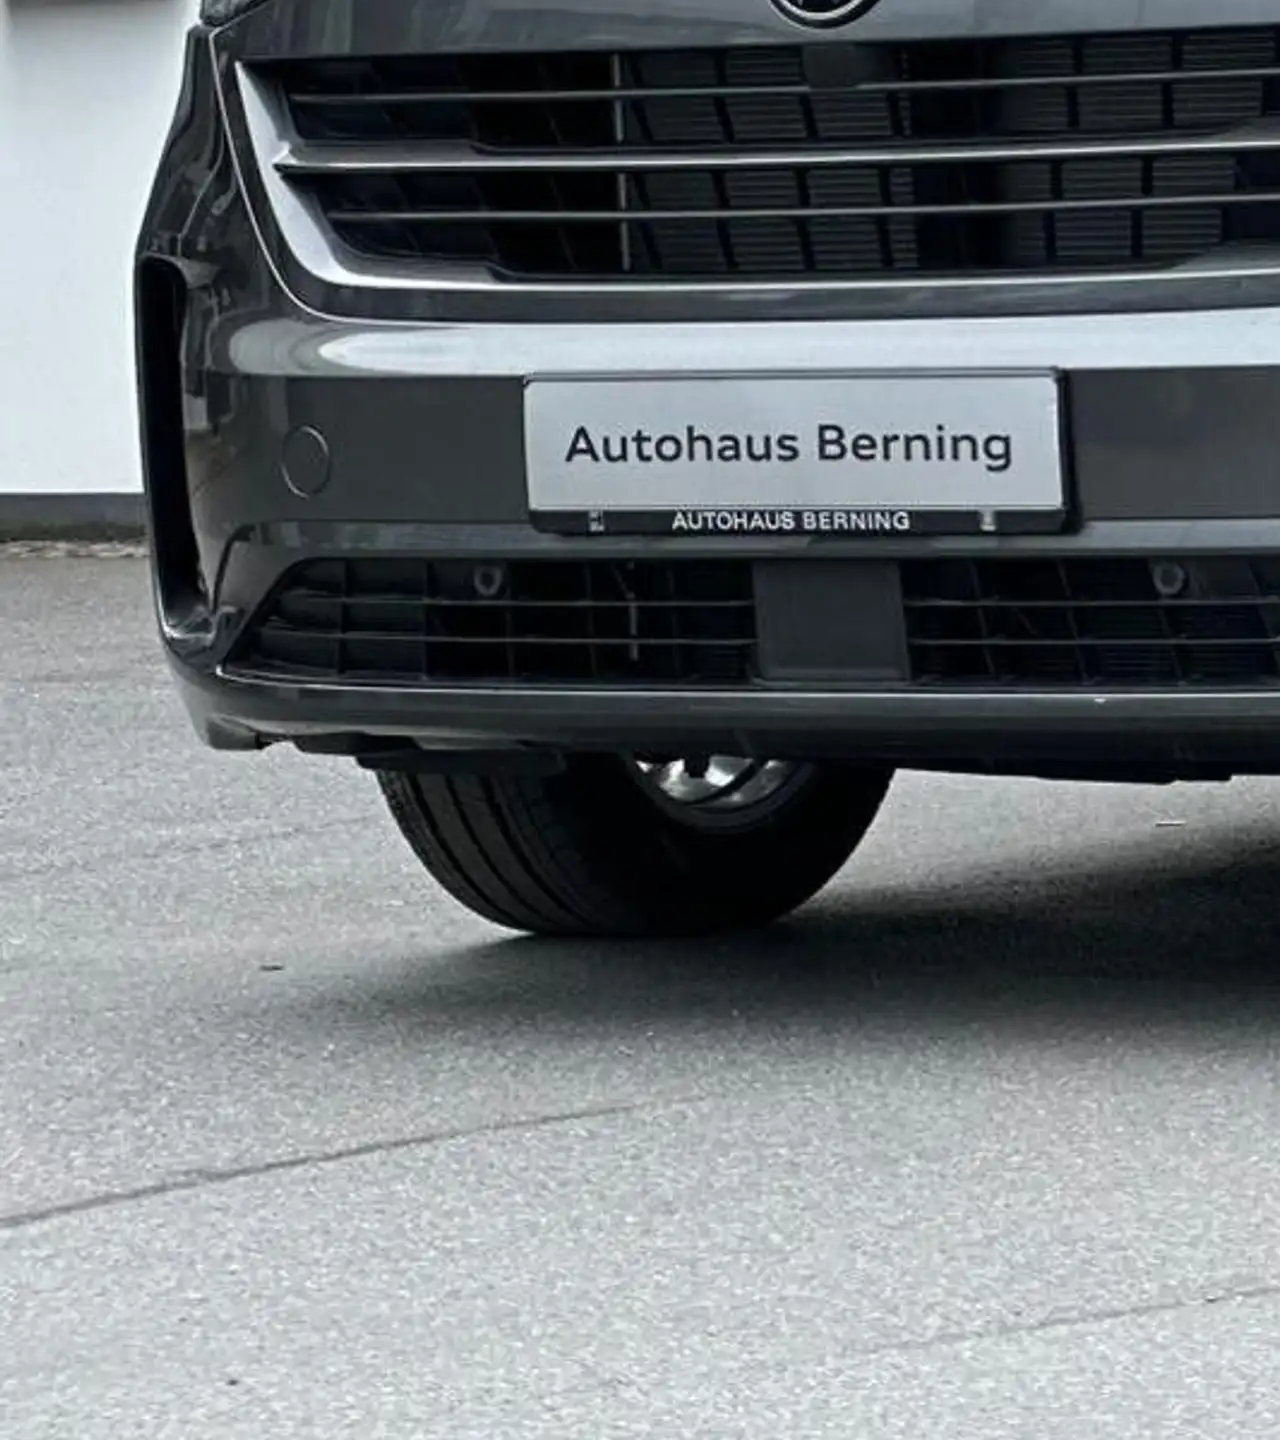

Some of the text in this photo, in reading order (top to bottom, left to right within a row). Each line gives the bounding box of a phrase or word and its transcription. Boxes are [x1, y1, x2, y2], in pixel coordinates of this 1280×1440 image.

[565, 423, 1012, 472] Autohaus Berning
[671, 510, 911, 530] AUTOHAUS BERNING
